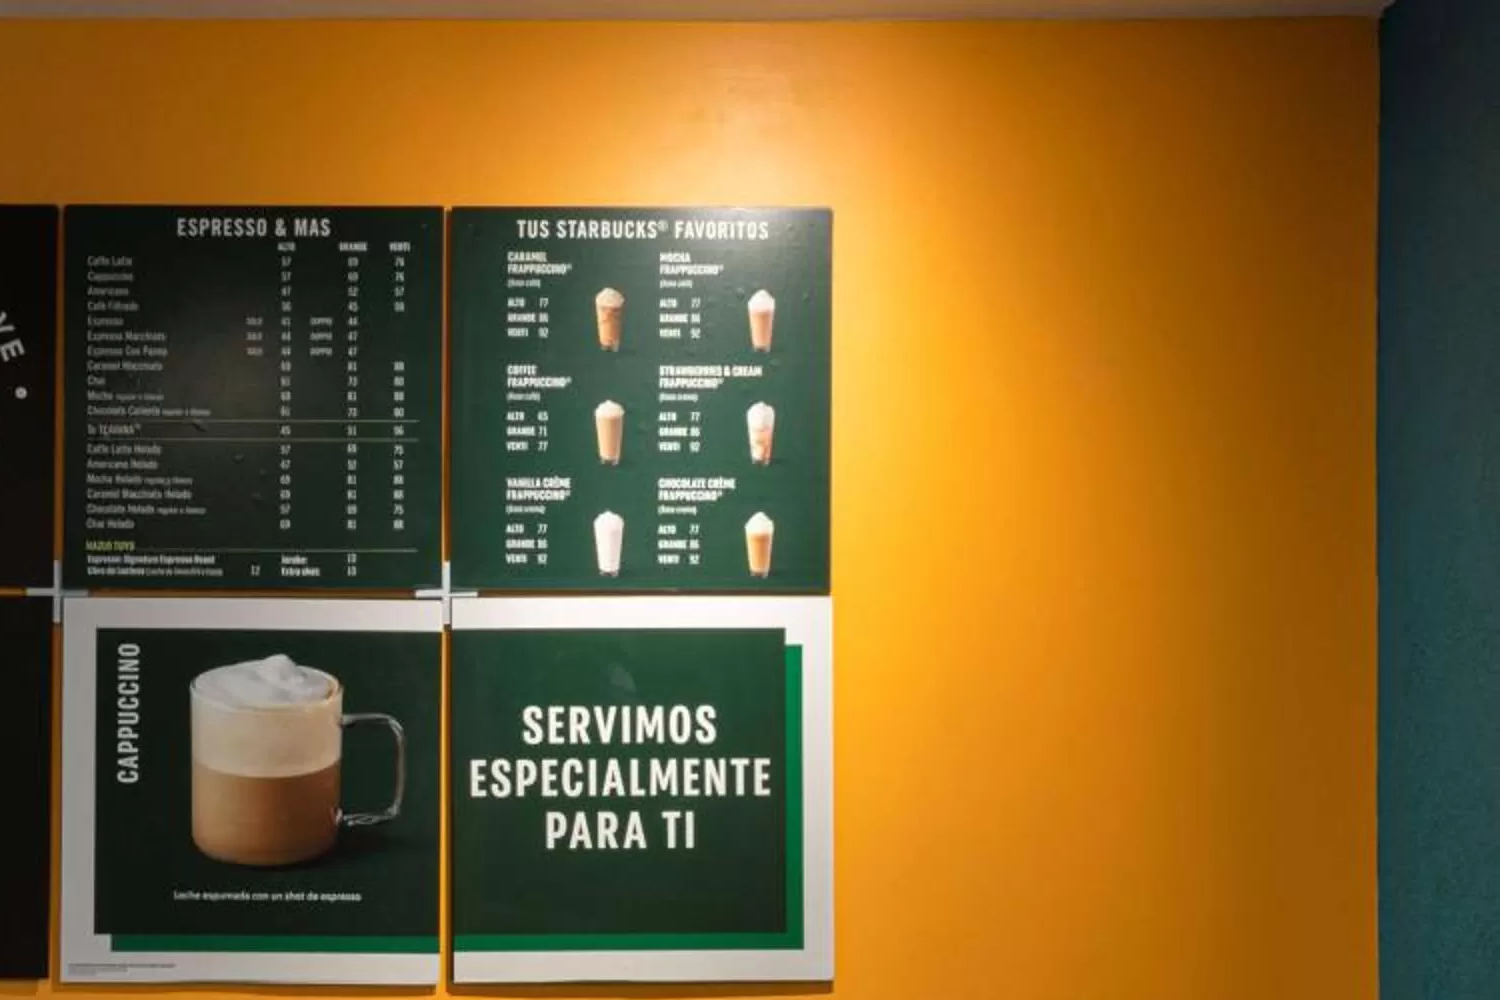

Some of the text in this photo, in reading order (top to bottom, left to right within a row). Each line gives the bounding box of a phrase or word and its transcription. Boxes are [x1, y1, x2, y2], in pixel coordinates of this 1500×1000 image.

[177, 218, 331, 237] ESPRESSO & MAS
[517, 219, 550, 239] TUS
[675, 219, 769, 239] FAVORITOS
[117, 643, 141, 784] CAPPUCCINO
[522, 704, 717, 745] SERVIMOS
[470, 758, 771, 798] ESPECIALMENTE
[545, 811, 695, 850] PARA TI
[174, 890, 200, 901] Leche
[202, 891, 250, 903] espumada
[252, 893, 269, 902] con
[285, 890, 305, 902] shot
[307, 891, 318, 902] de
[320, 893, 362, 904] espresso
